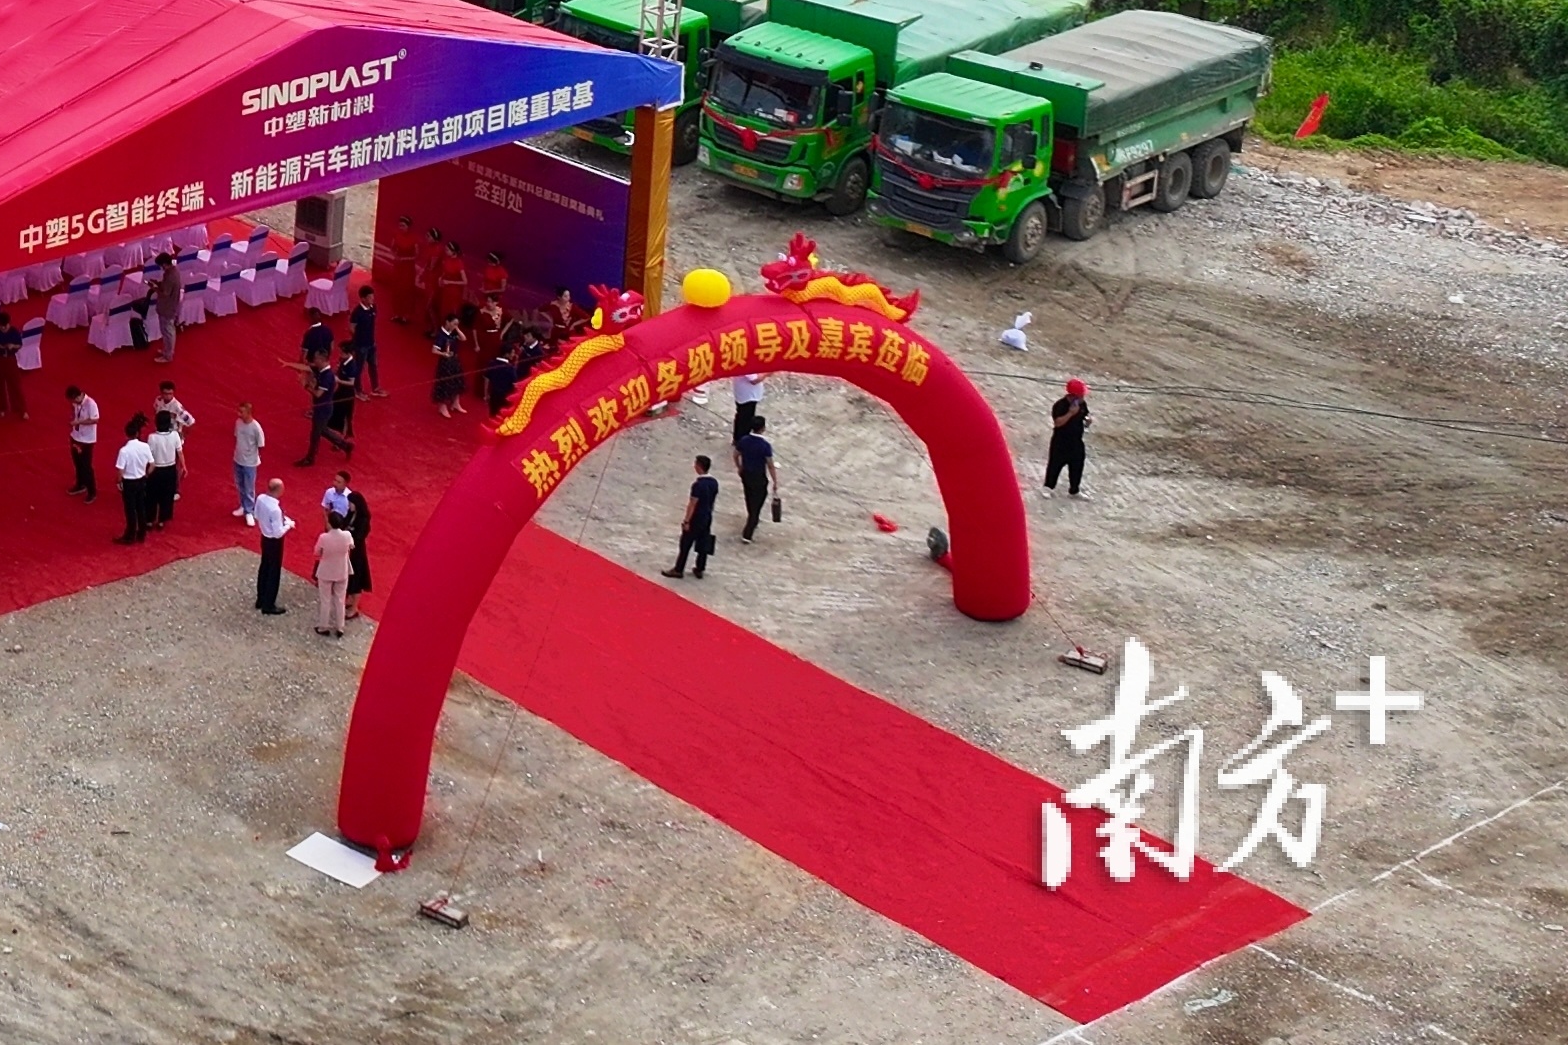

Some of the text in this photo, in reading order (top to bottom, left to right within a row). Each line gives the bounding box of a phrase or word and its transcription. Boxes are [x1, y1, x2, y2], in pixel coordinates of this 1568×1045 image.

[240, 54, 400, 116] SINOPLAST
[264, 93, 375, 139] 中塑新材料
[18, 79, 595, 254] 中塑5G智能终端、新能源汽车新材料总部项目隆重奠基
[474, 178, 523, 214] 签到处
[522, 316, 930, 499] 热烈欢迎各级领导及嘉宾莅临
